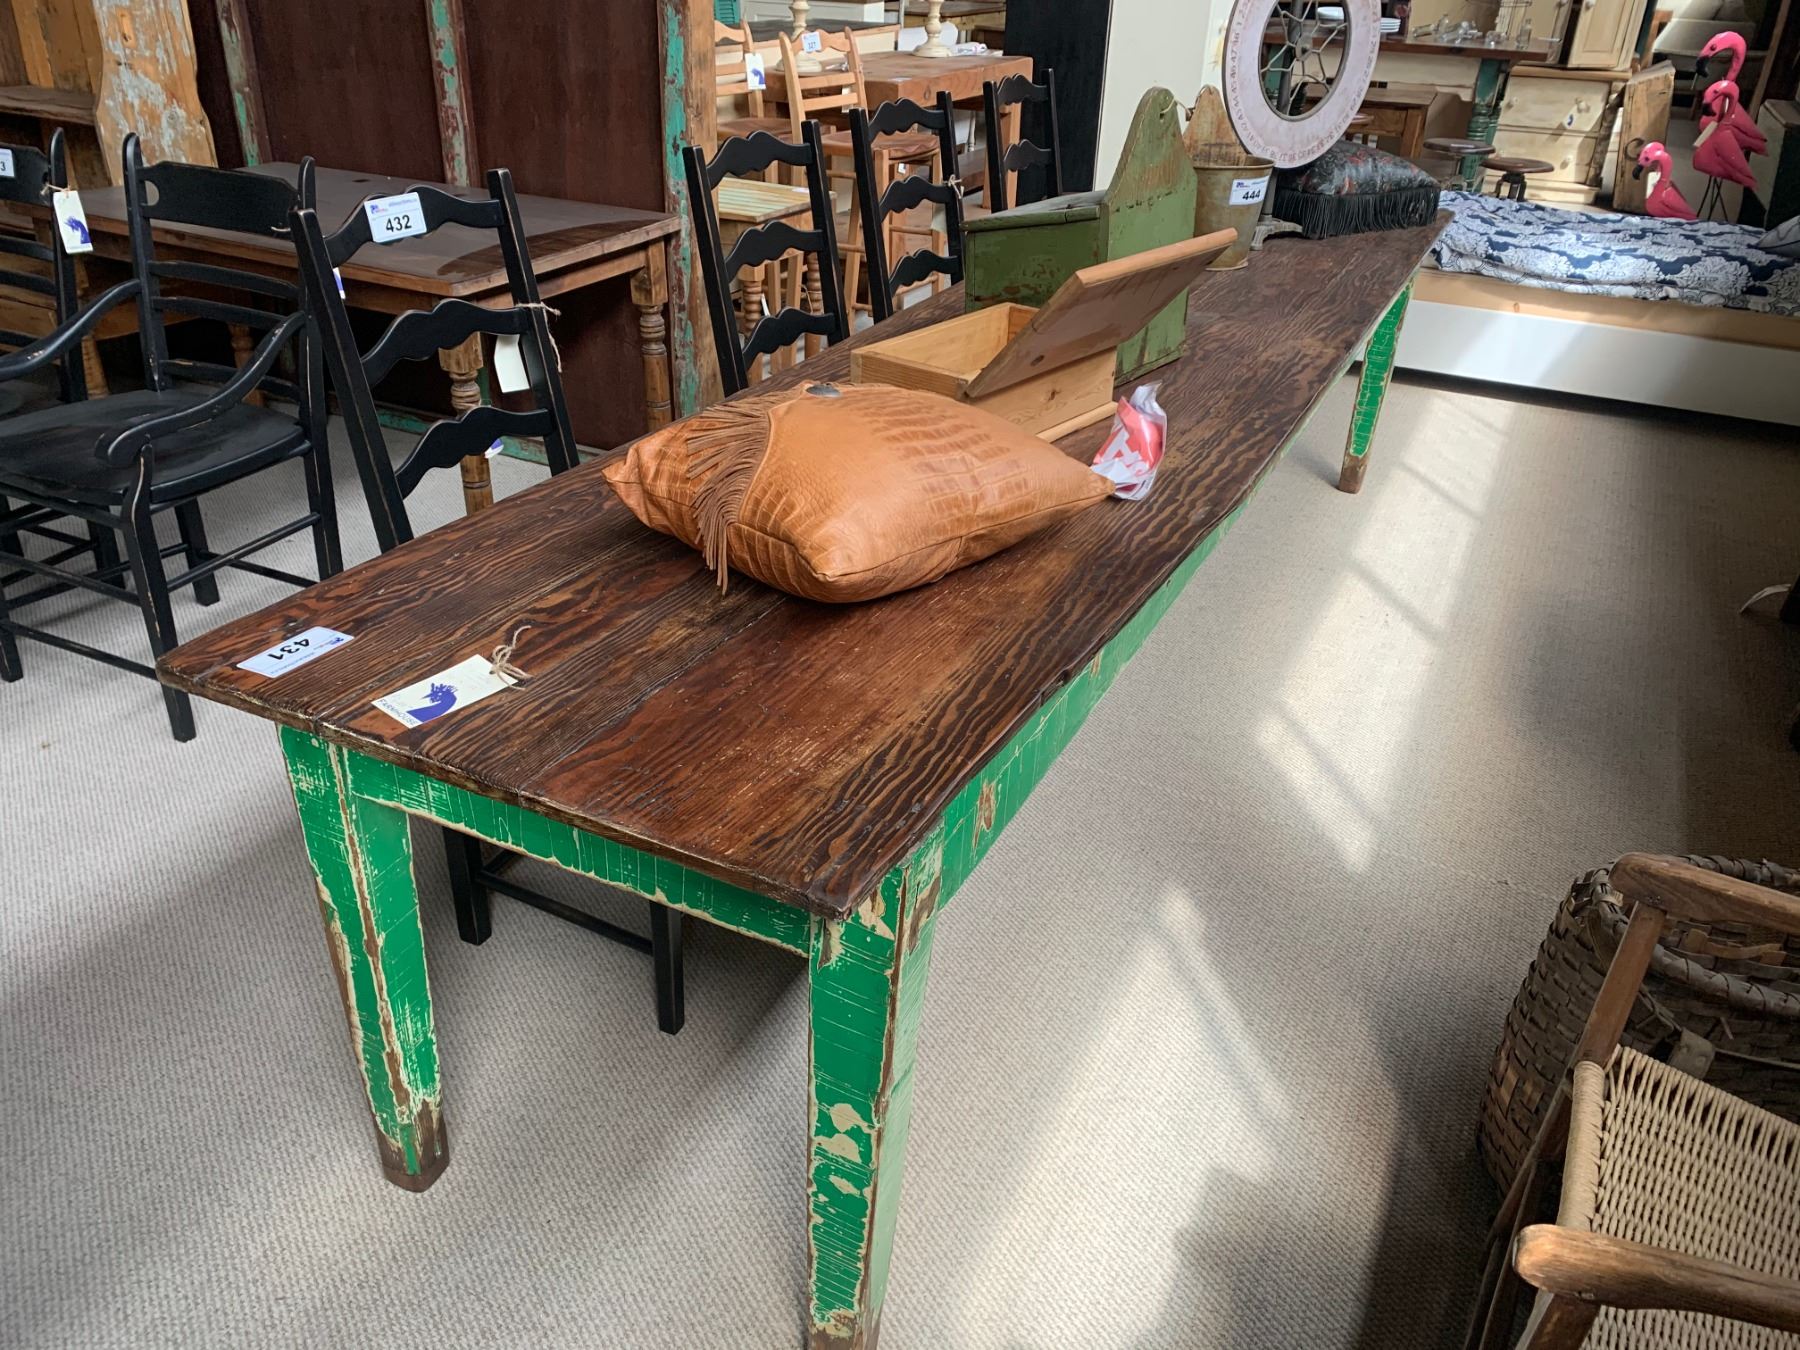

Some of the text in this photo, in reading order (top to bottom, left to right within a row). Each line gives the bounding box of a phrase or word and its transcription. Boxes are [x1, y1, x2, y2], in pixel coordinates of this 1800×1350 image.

[1242, 189, 1261, 200] 444
[386, 214, 412, 232] 432
[267, 638, 310, 660] 431
